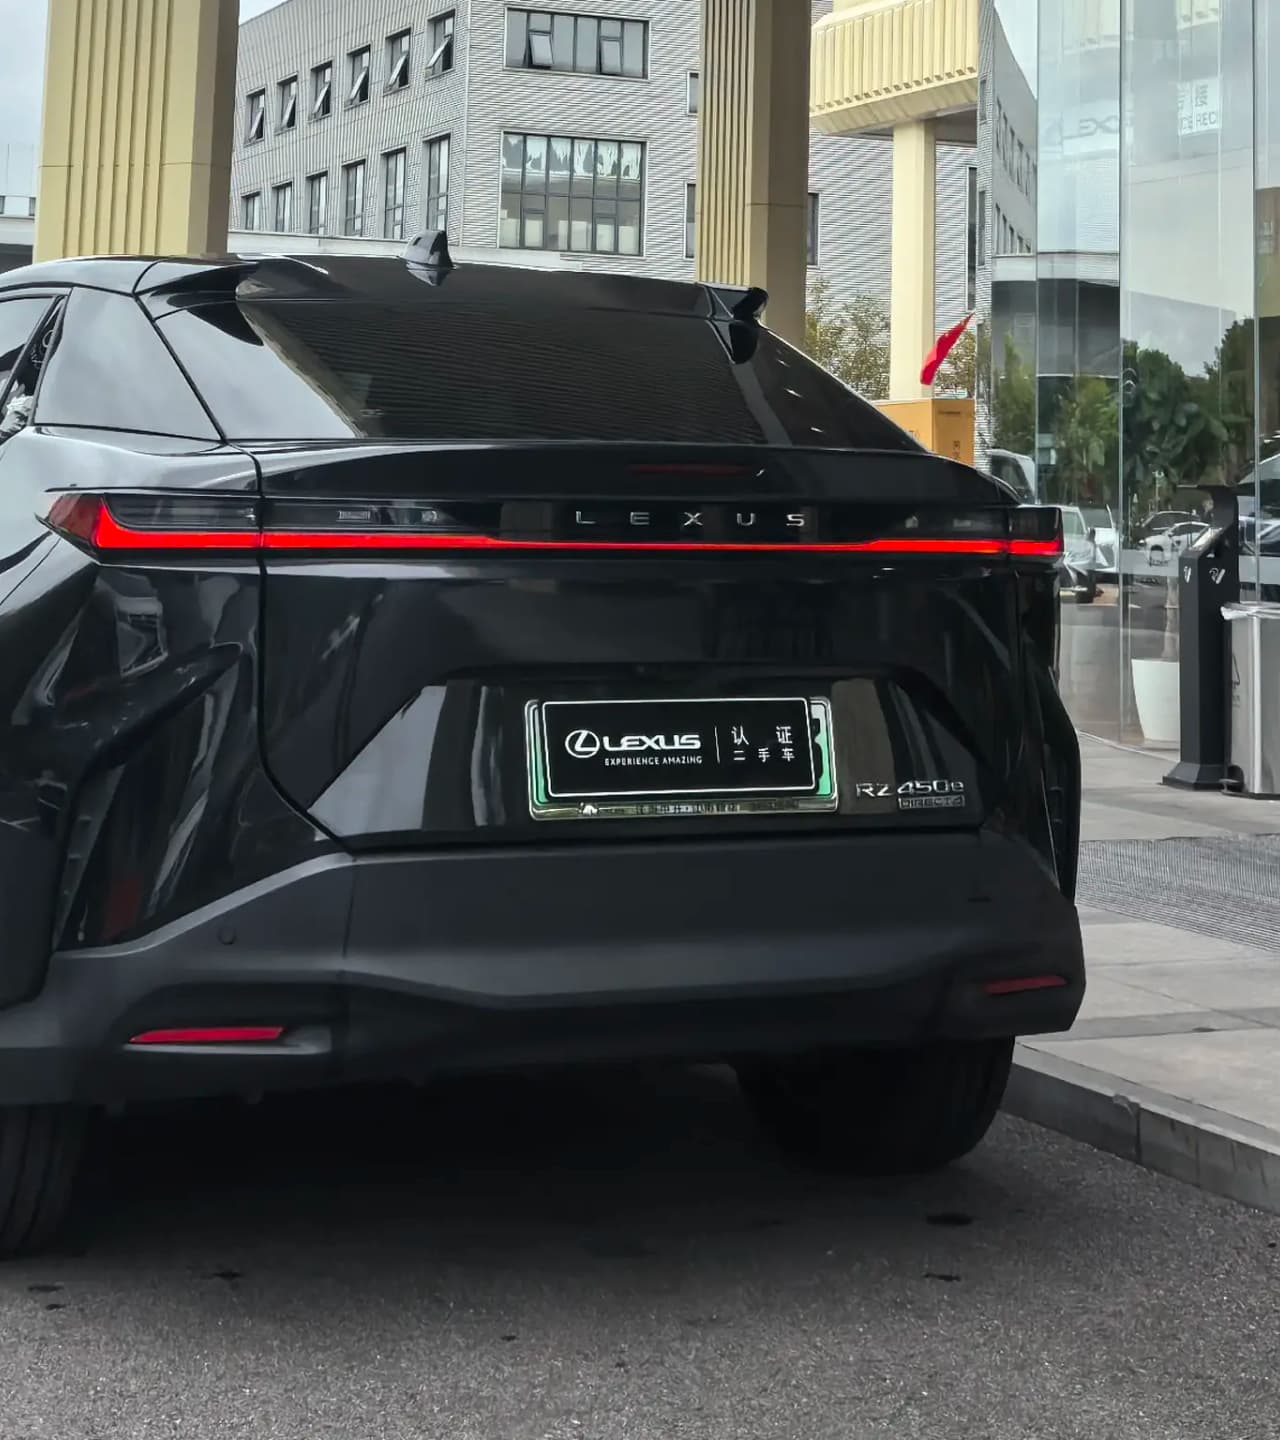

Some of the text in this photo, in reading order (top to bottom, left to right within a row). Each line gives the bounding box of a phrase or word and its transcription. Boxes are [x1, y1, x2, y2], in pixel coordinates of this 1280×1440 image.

[575, 510, 805, 526] LEXUS
[603, 734, 701, 752] LEXUS
[731, 726, 793, 745] 认证
[604, 755, 703, 766] EXPERIENCE AMAZING
[733, 748, 795, 762] 二手车
[855, 780, 965, 797] RZ 450e
